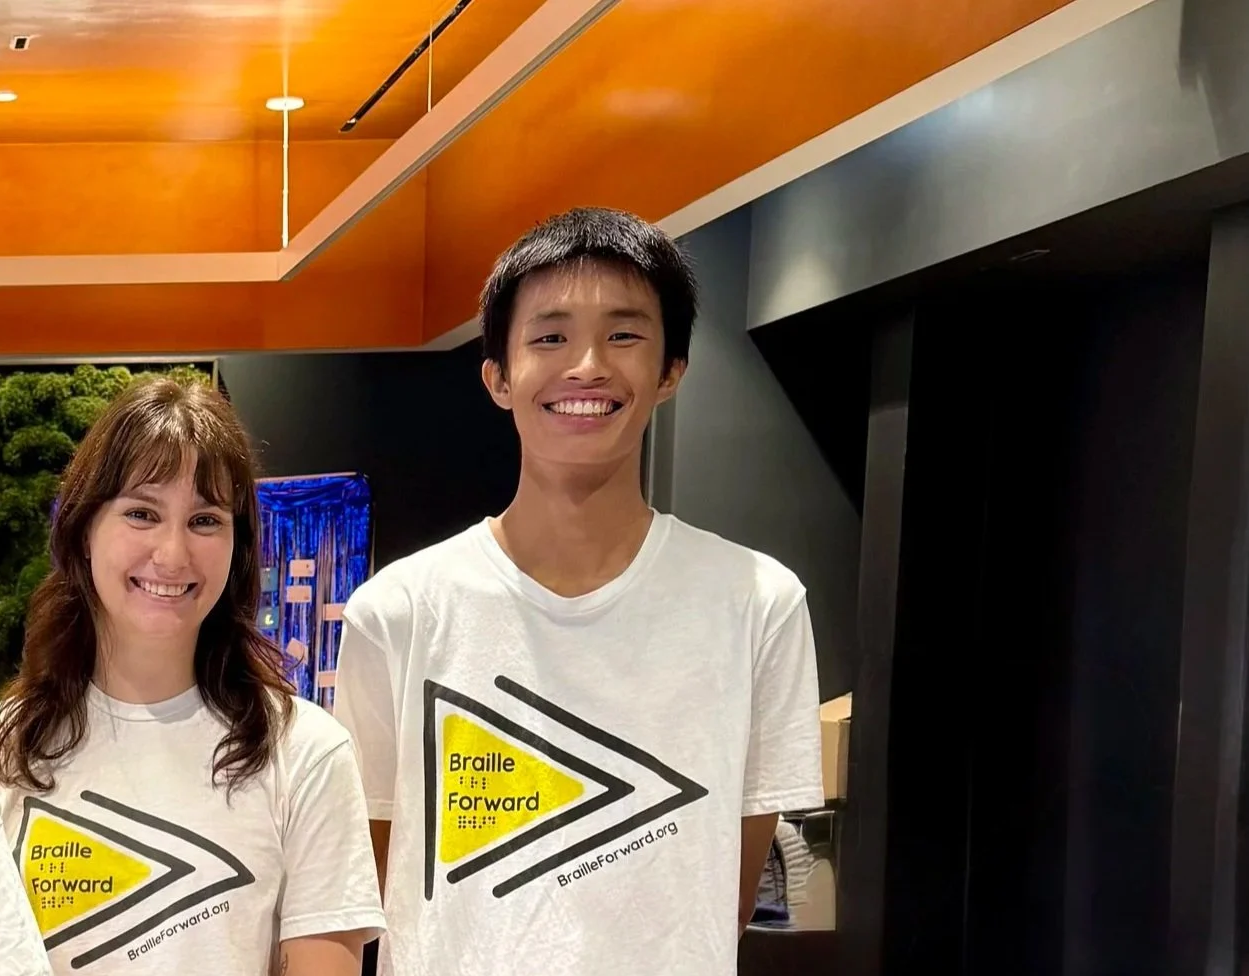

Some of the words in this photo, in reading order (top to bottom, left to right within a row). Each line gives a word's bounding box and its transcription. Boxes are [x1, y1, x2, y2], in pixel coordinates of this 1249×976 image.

[449, 752, 515, 772] Braille
[448, 792, 540, 812] Forward
[31, 841, 93, 860] Braille
[557, 821, 678, 887] BrailleForward.org
[31, 876, 113, 895] Forward
[127, 900, 230, 962] BrailleForward.org
